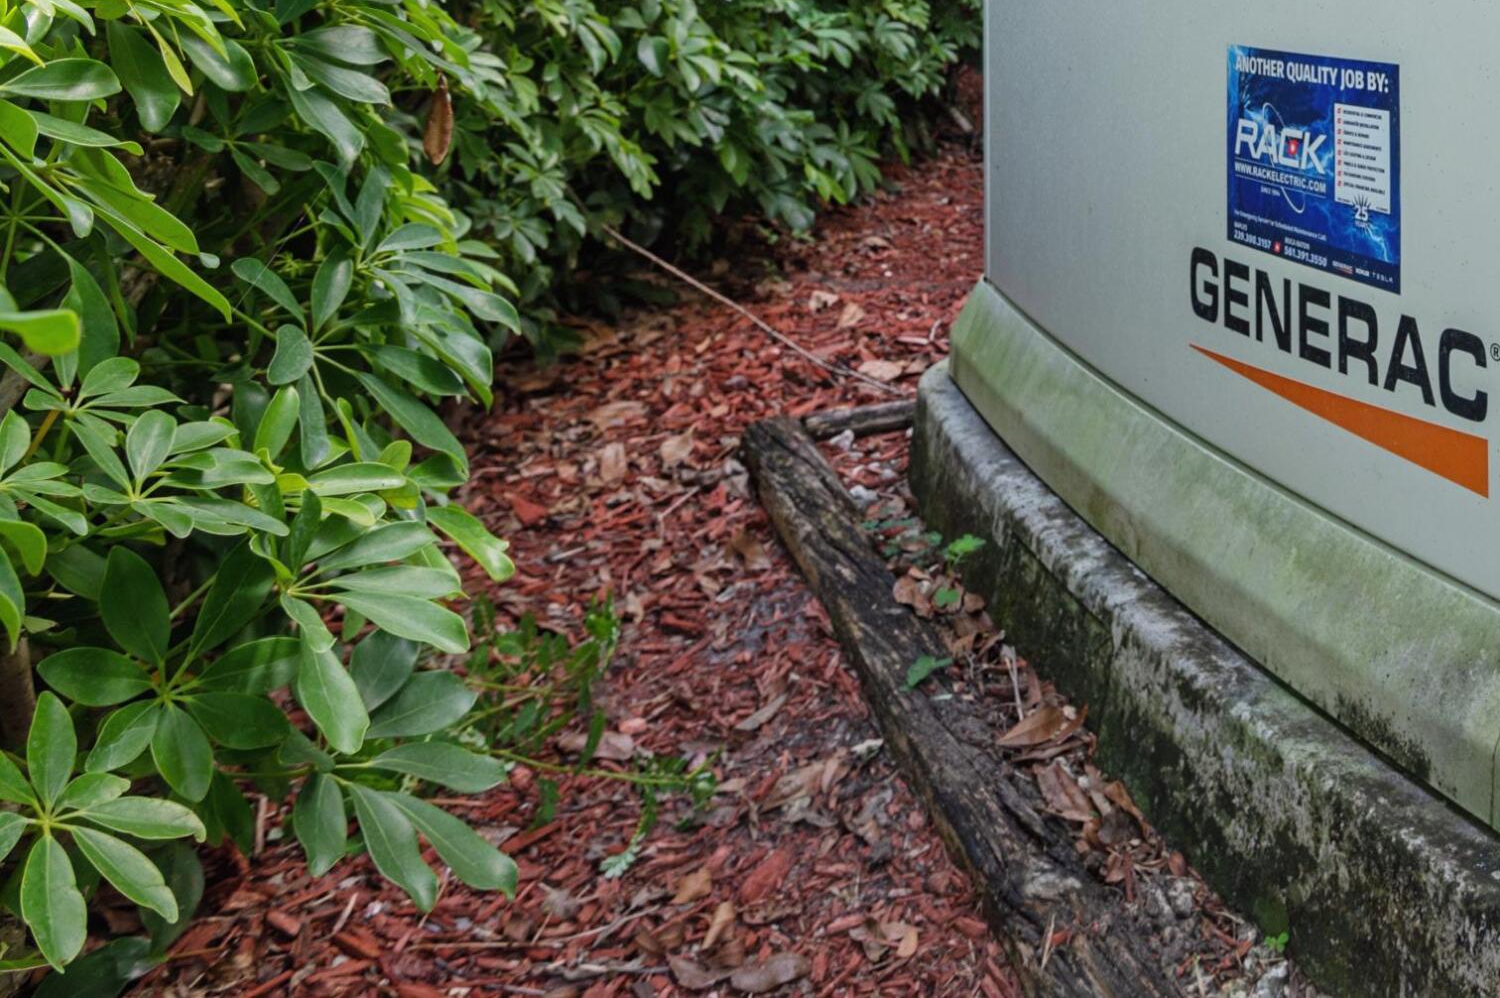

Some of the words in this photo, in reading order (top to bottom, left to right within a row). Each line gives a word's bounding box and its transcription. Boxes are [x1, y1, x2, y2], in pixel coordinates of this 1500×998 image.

[1235, 55, 1285, 79] ANOTHER
[1286, 61, 1338, 86] QUALITY
[1340, 68, 1364, 90] JOB
[1367, 71, 1389, 93] BY:
[1235, 118, 1327, 174] RACK
[1190, 246, 1489, 422] GENERAC
